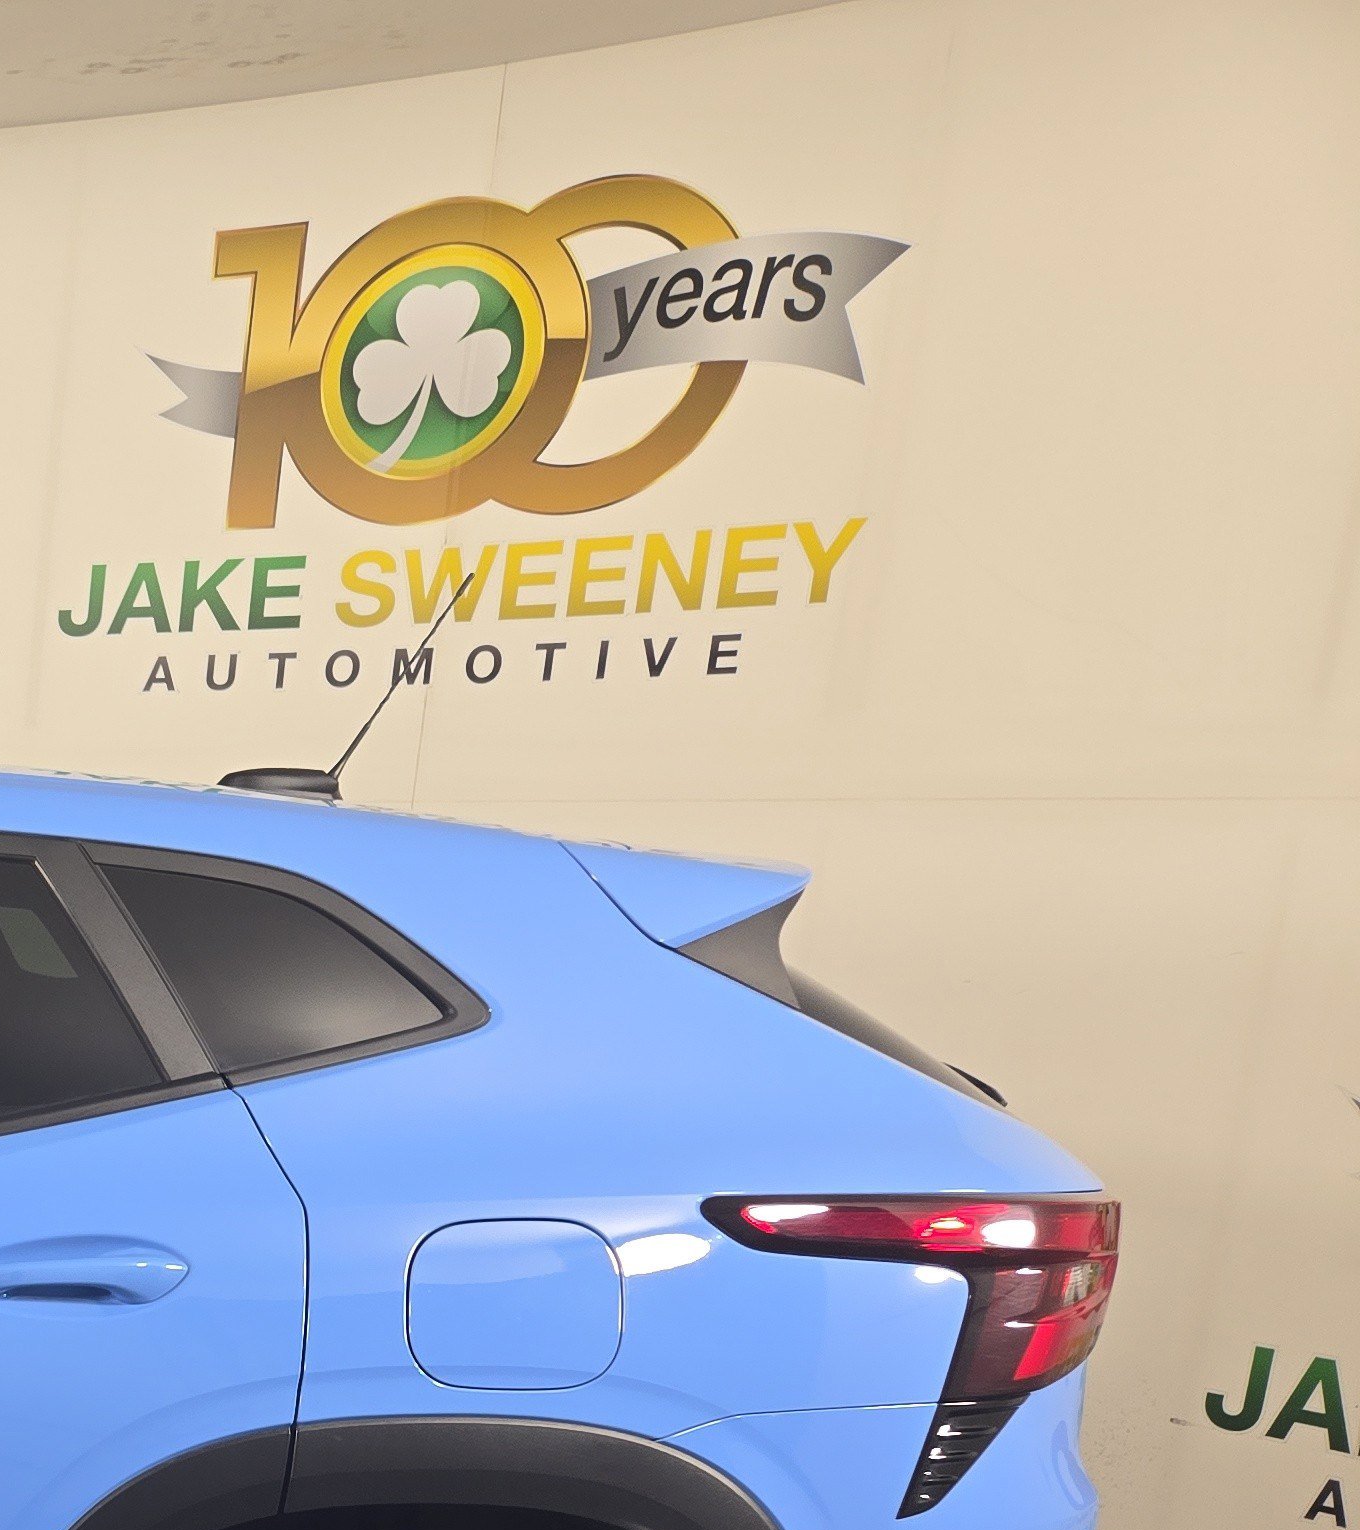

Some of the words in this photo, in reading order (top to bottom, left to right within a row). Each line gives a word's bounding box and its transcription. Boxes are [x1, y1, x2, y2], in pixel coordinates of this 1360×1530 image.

[601, 250, 835, 364] years
[56, 555, 308, 637] JAKE
[334, 516, 869, 629] SWEENEY
[142, 632, 744, 693] AUTOMOTIVE
[1205, 1346, 1360, 1457] JA
[1303, 1478, 1347, 1529] A
